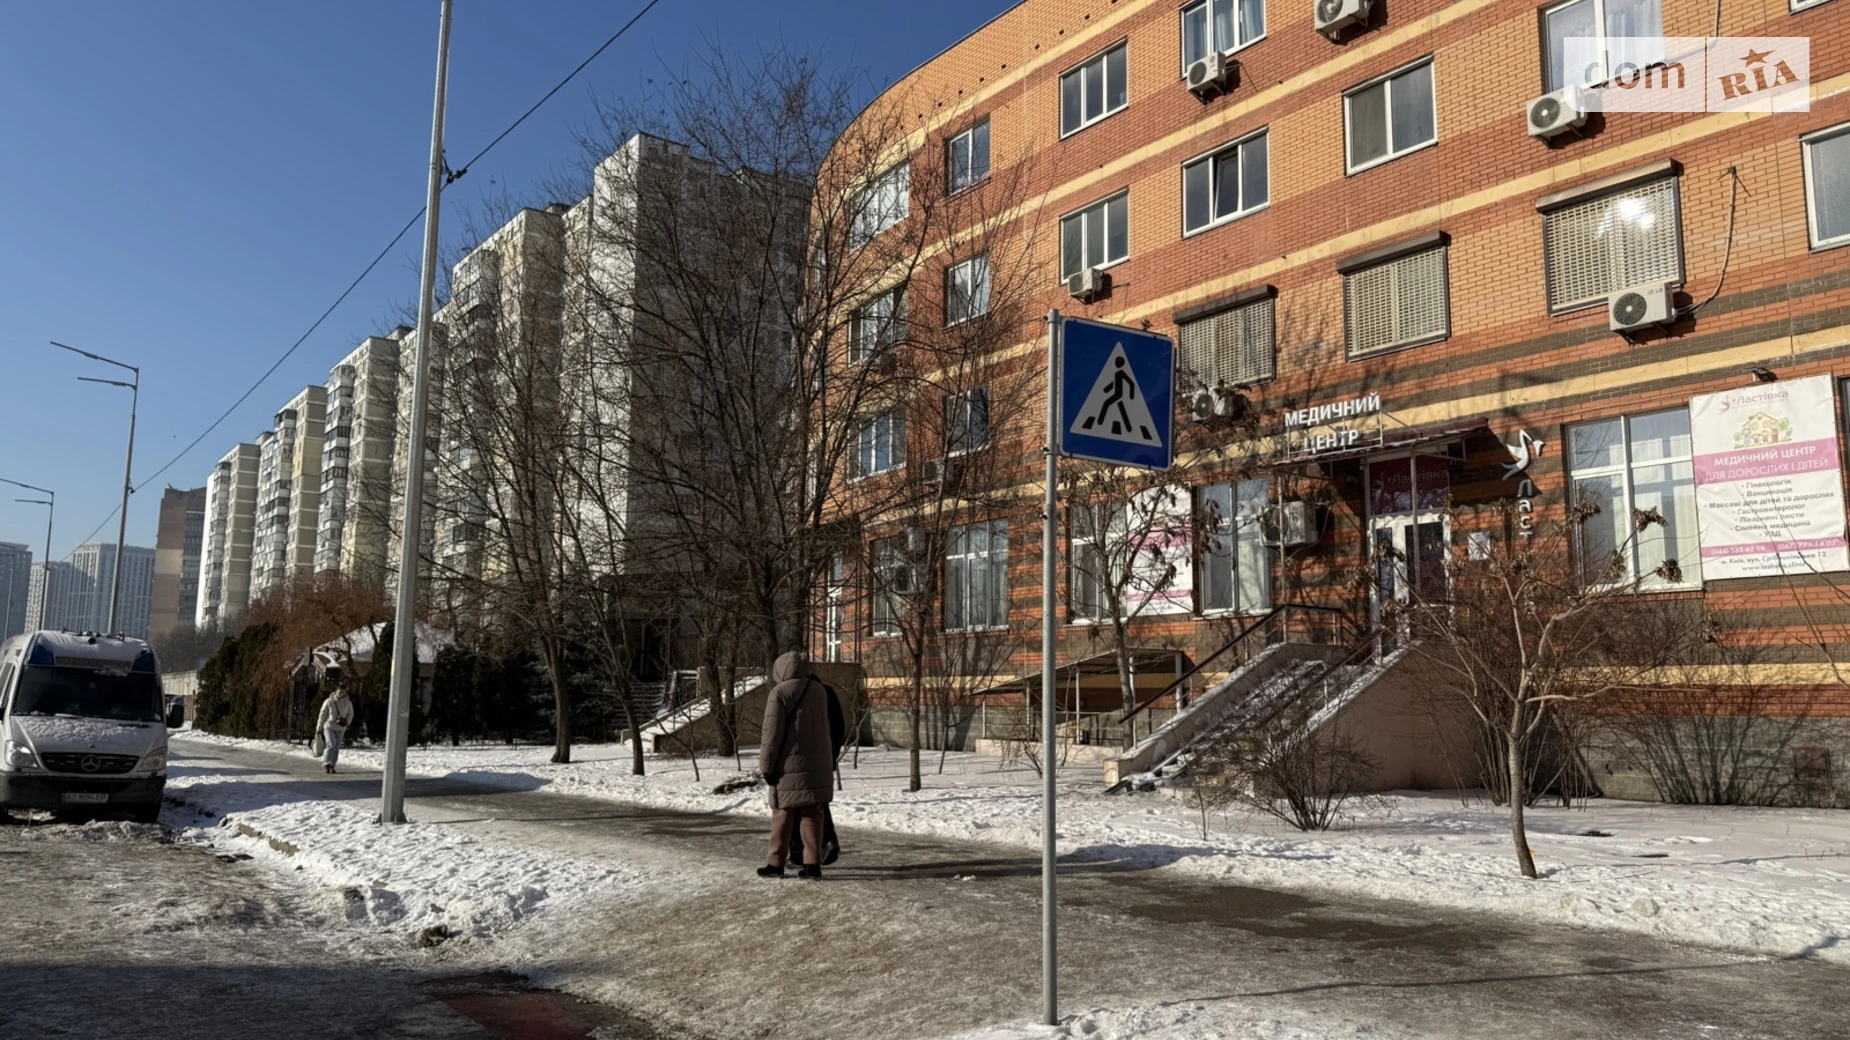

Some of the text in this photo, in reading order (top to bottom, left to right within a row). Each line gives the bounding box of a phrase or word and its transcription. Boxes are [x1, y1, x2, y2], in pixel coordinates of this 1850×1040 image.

[1284, 392, 1381, 427] МЕДИЧНИЙ
[1303, 429, 1360, 454] ЦЕНТР
[1714, 446, 1816, 466] МЕДИЧНИЙ ЦЕНТР
[1705, 471, 1725, 481] ДЛЯ
[1727, 463, 1789, 479] ДОРОСЛИХ
[1797, 457, 1829, 471] ДІТЕЙ
